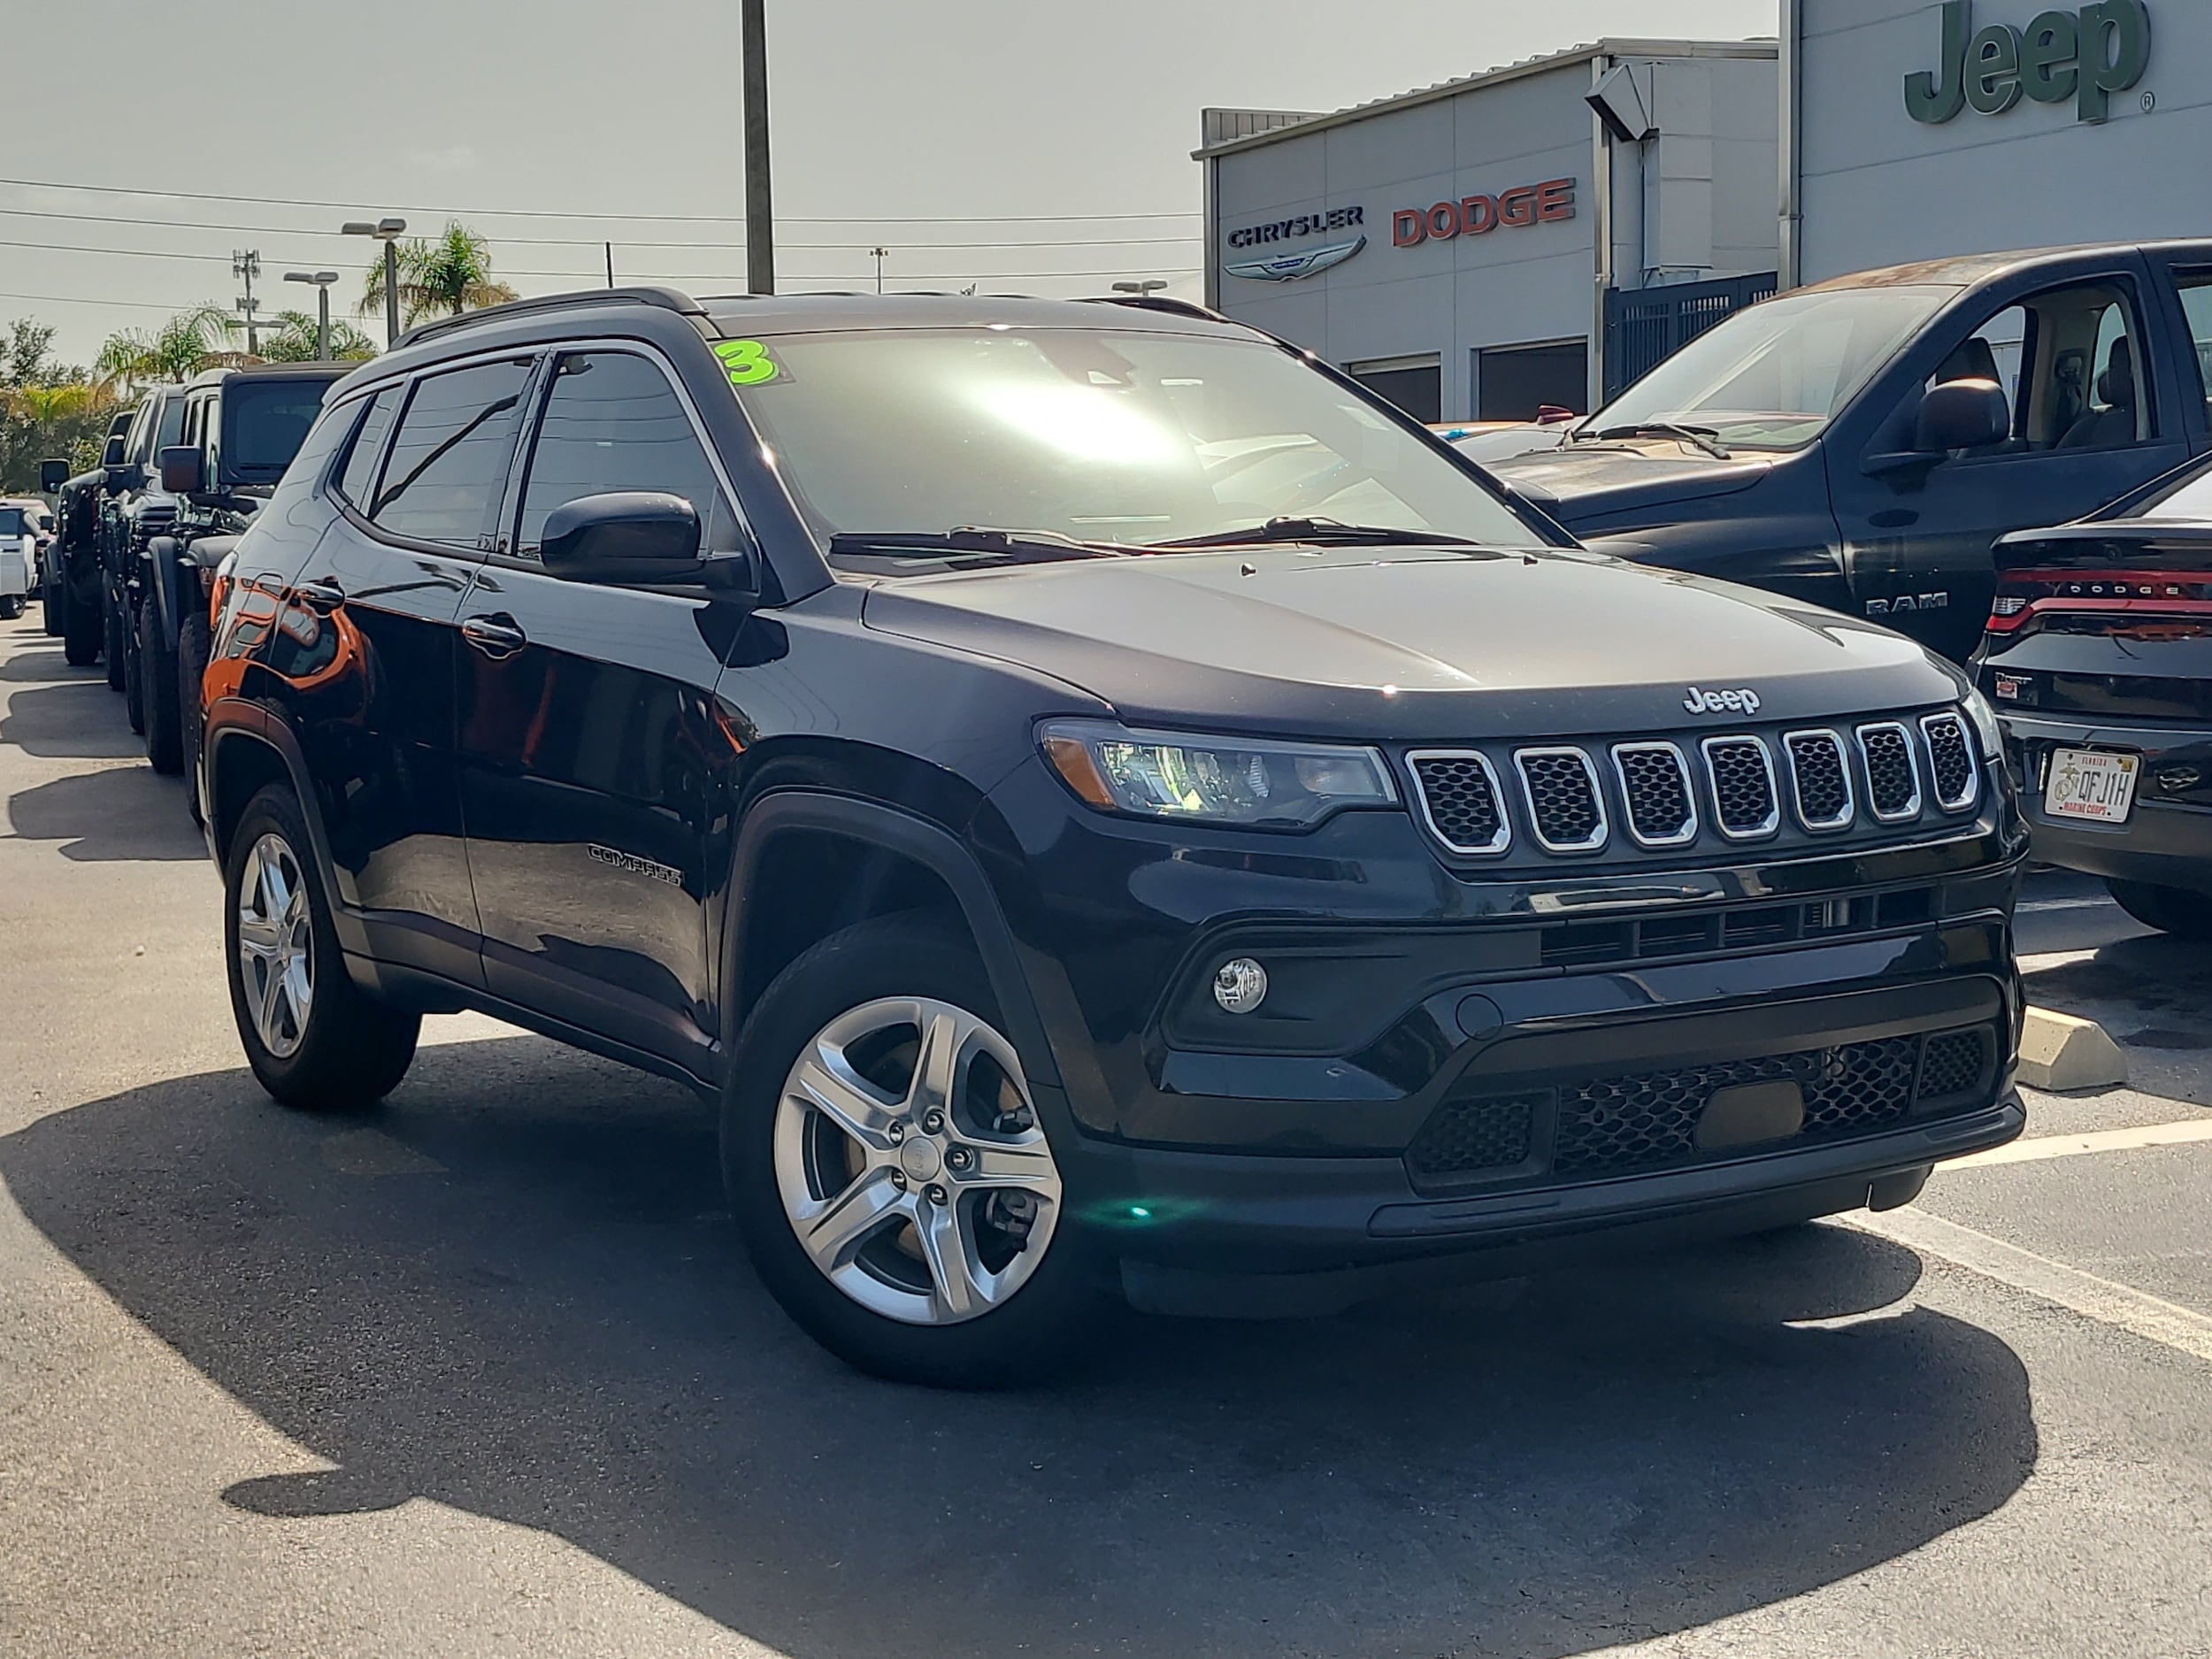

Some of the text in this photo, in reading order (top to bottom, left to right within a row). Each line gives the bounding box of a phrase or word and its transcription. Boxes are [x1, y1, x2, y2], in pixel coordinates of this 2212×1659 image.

[1903, 0, 2151, 124] Jeep
[1227, 206, 1364, 249] CHRYSLER
[1393, 176, 1577, 248] DODGE
[713, 340, 780, 386] 3
[1865, 591, 1947, 615] RAM
[2070, 585, 2179, 595] DODGE
[1683, 686, 1761, 715] Jeep
[2078, 771, 2130, 806] QFJ1H
[587, 842, 682, 887] COMPASS
